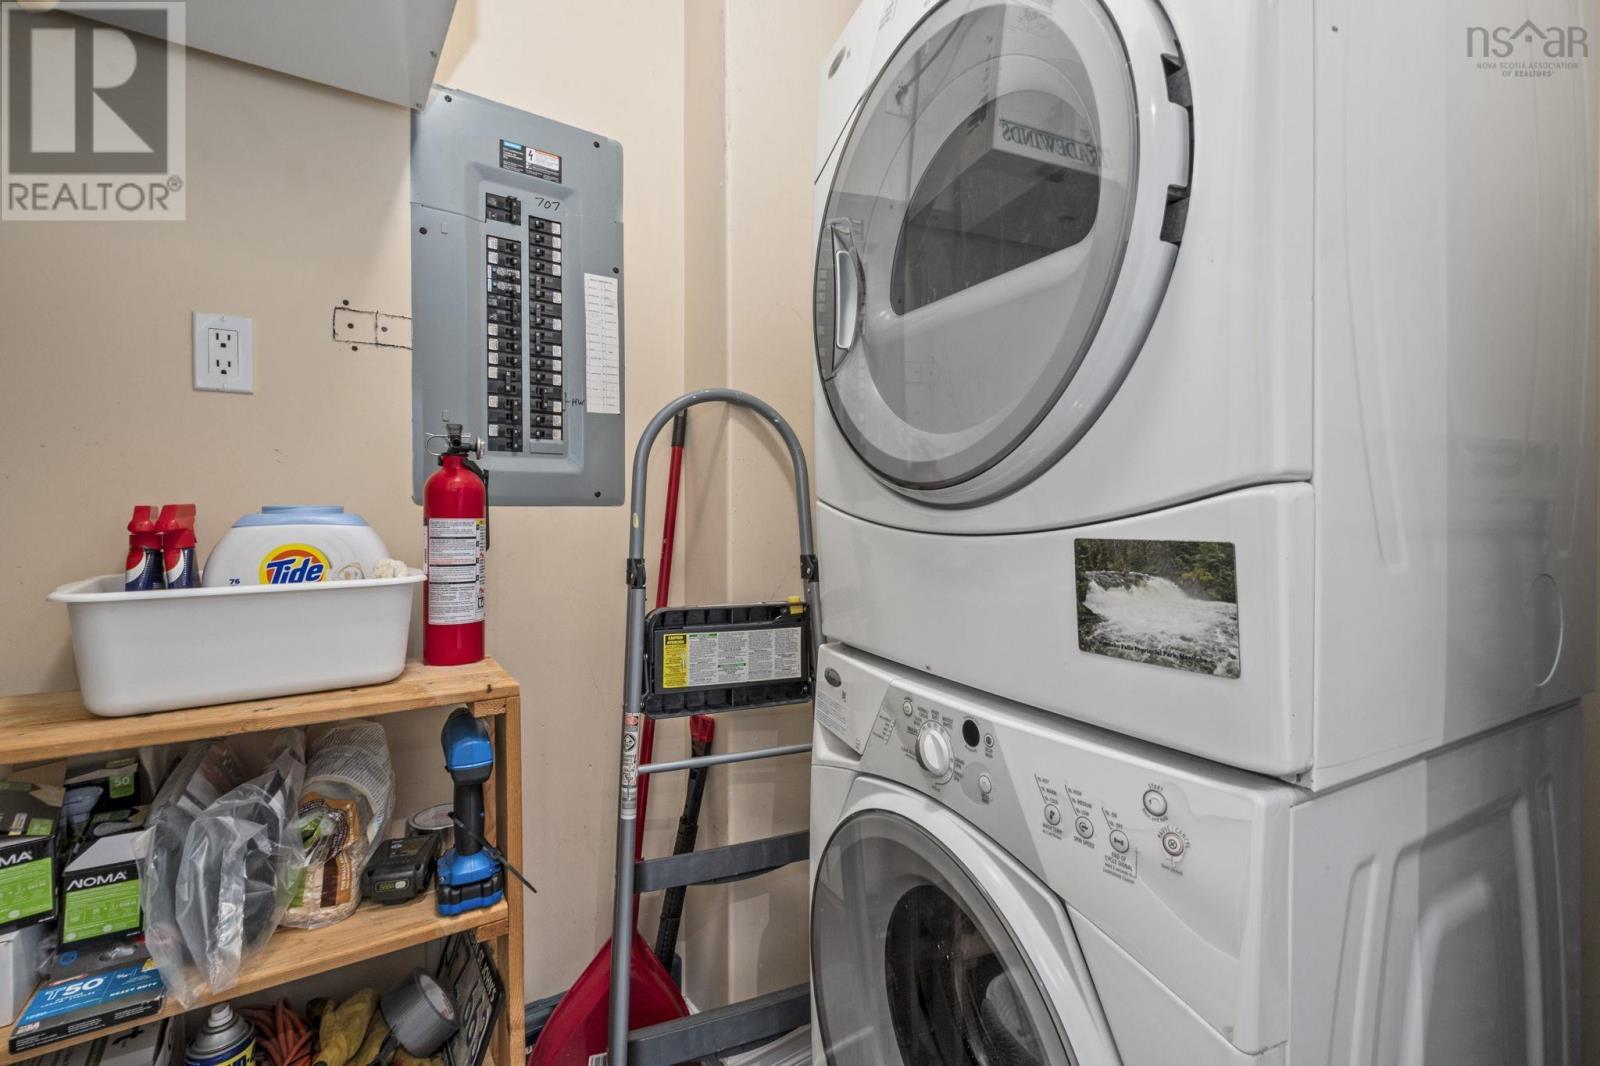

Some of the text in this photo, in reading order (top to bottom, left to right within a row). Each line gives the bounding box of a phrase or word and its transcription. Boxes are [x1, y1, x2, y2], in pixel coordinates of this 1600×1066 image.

[535, 196, 561, 211] 707
[266, 557, 324, 584] Tide
[66, 871, 127, 891] NOMA
[45, 977, 105, 1000] T50
